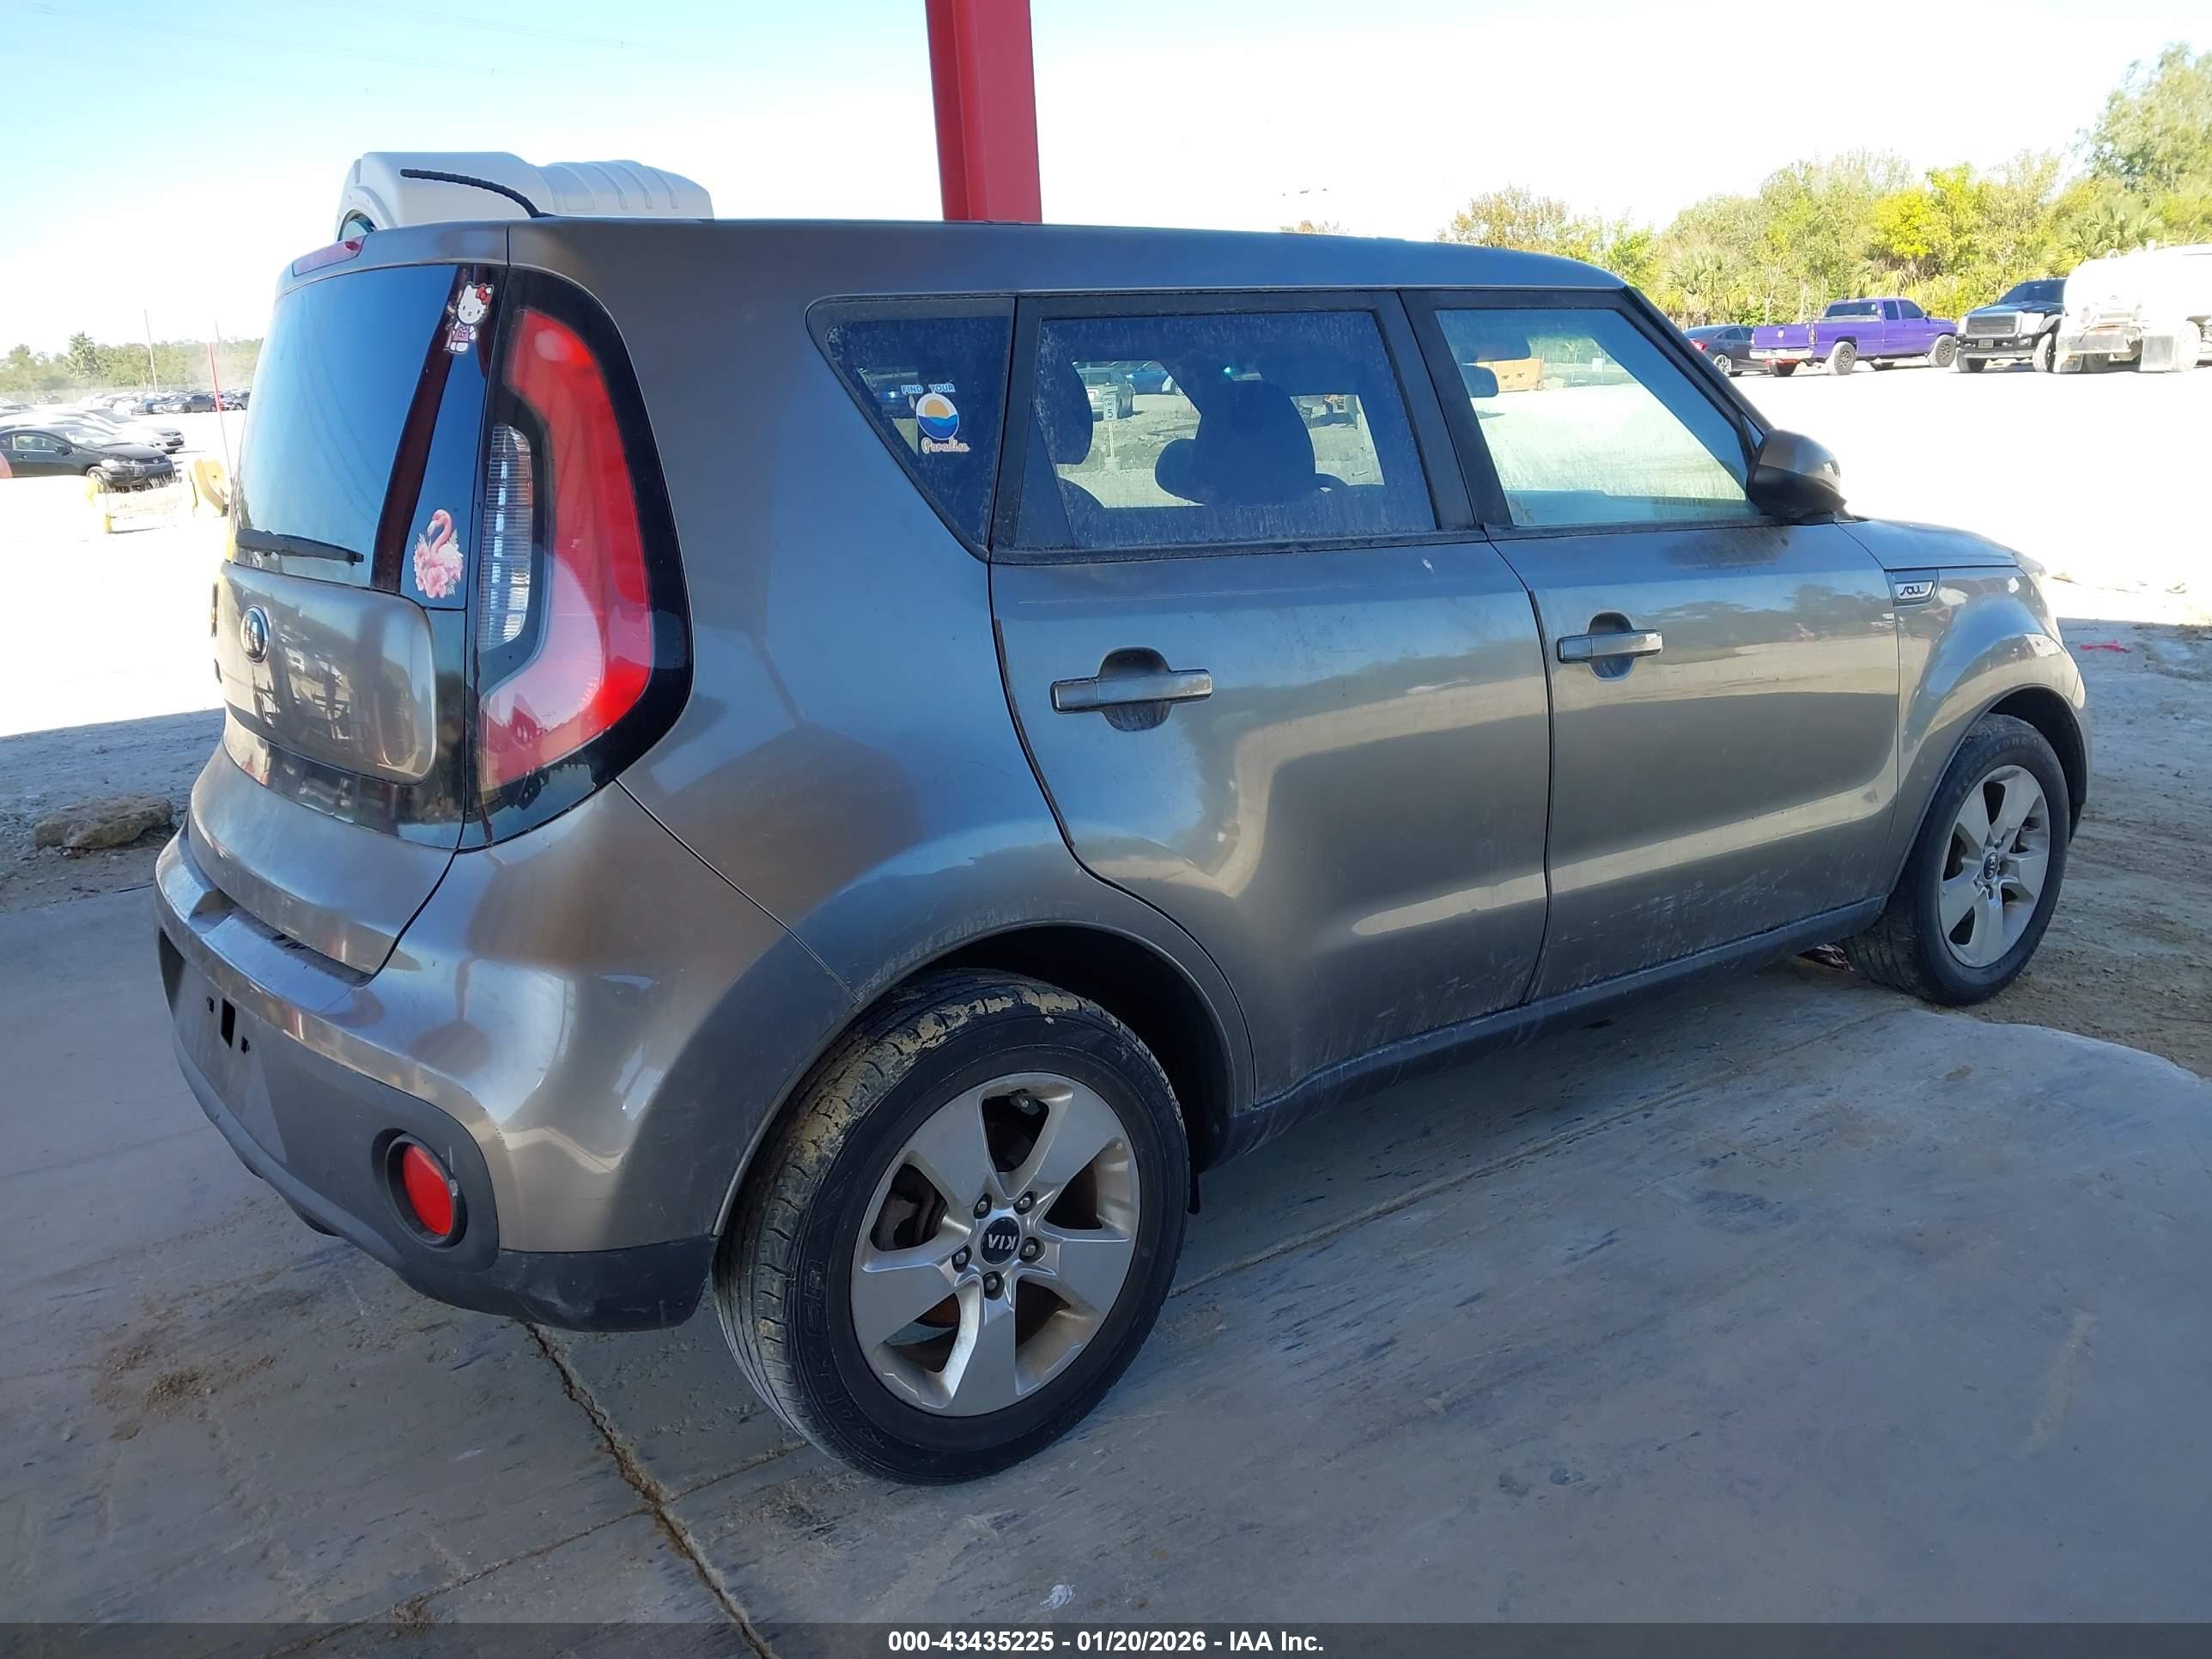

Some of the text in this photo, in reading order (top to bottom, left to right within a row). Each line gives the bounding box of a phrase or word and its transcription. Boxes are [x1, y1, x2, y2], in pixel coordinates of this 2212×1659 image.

[901, 383, 955, 394] FIND YOUR
[1108, 409, 1113, 418] 5
[921, 436, 970, 454] Paradise
[1899, 585, 1925, 596] SOUL
[988, 1233, 1017, 1250] KIA
